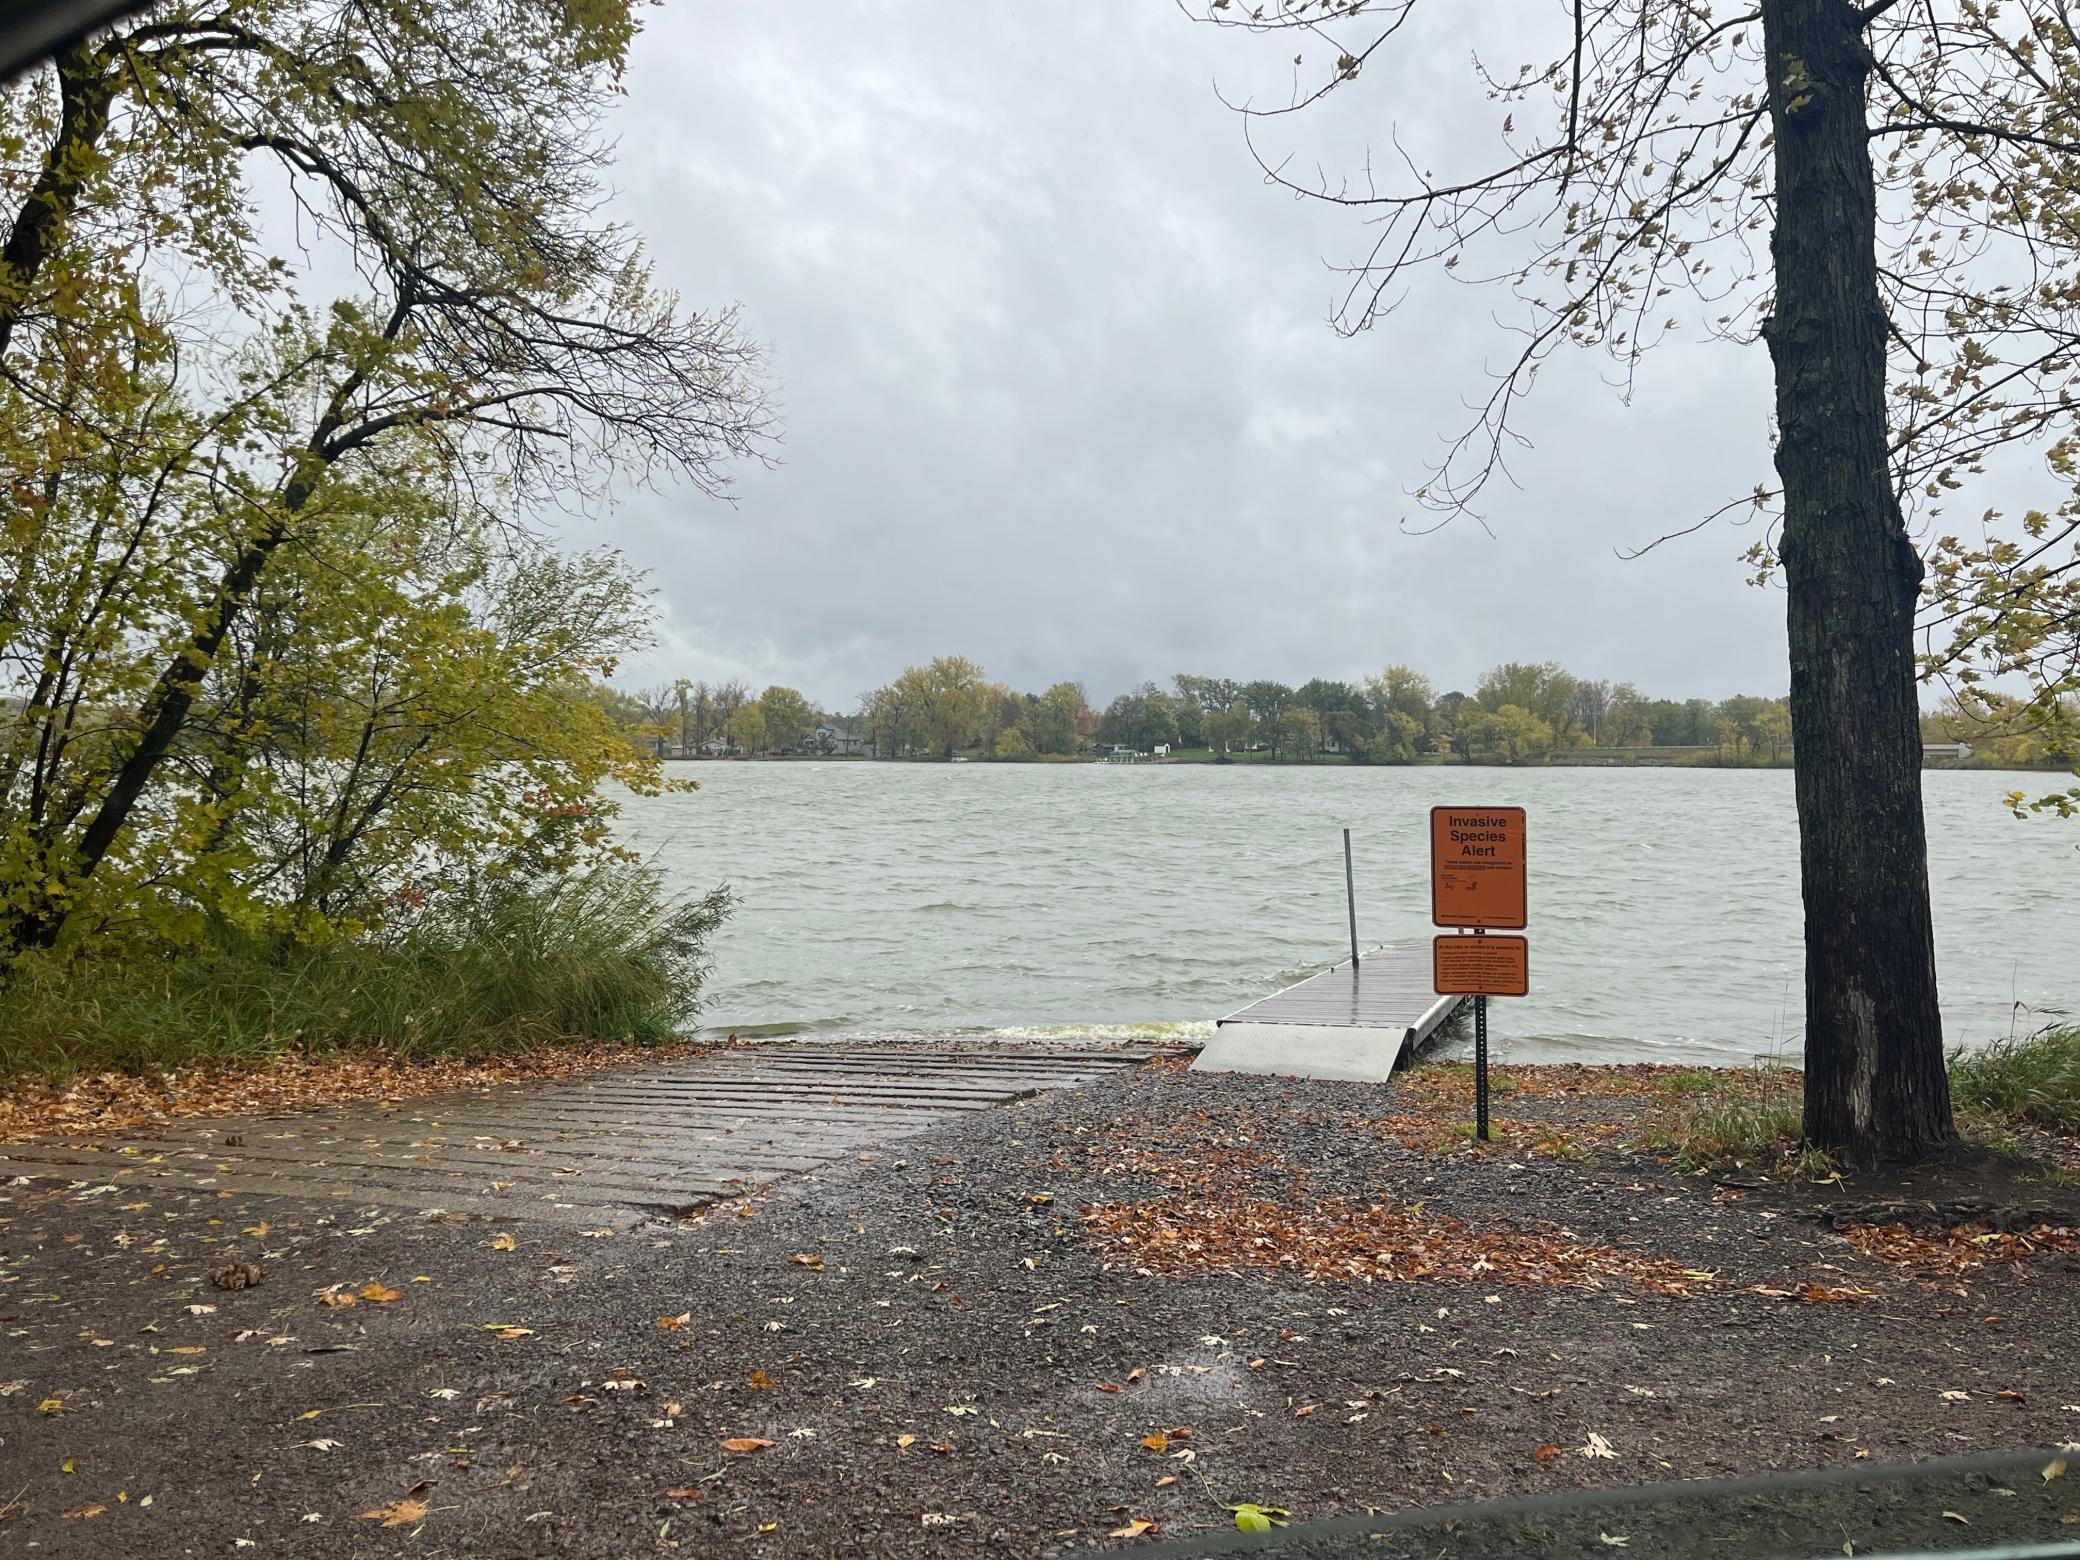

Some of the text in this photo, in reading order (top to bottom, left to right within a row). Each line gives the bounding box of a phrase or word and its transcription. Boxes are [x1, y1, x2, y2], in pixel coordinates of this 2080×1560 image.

[1449, 815, 1507, 827] Invasive
[1450, 830, 1506, 844] Species
[1461, 845, 1496, 856] Alert
